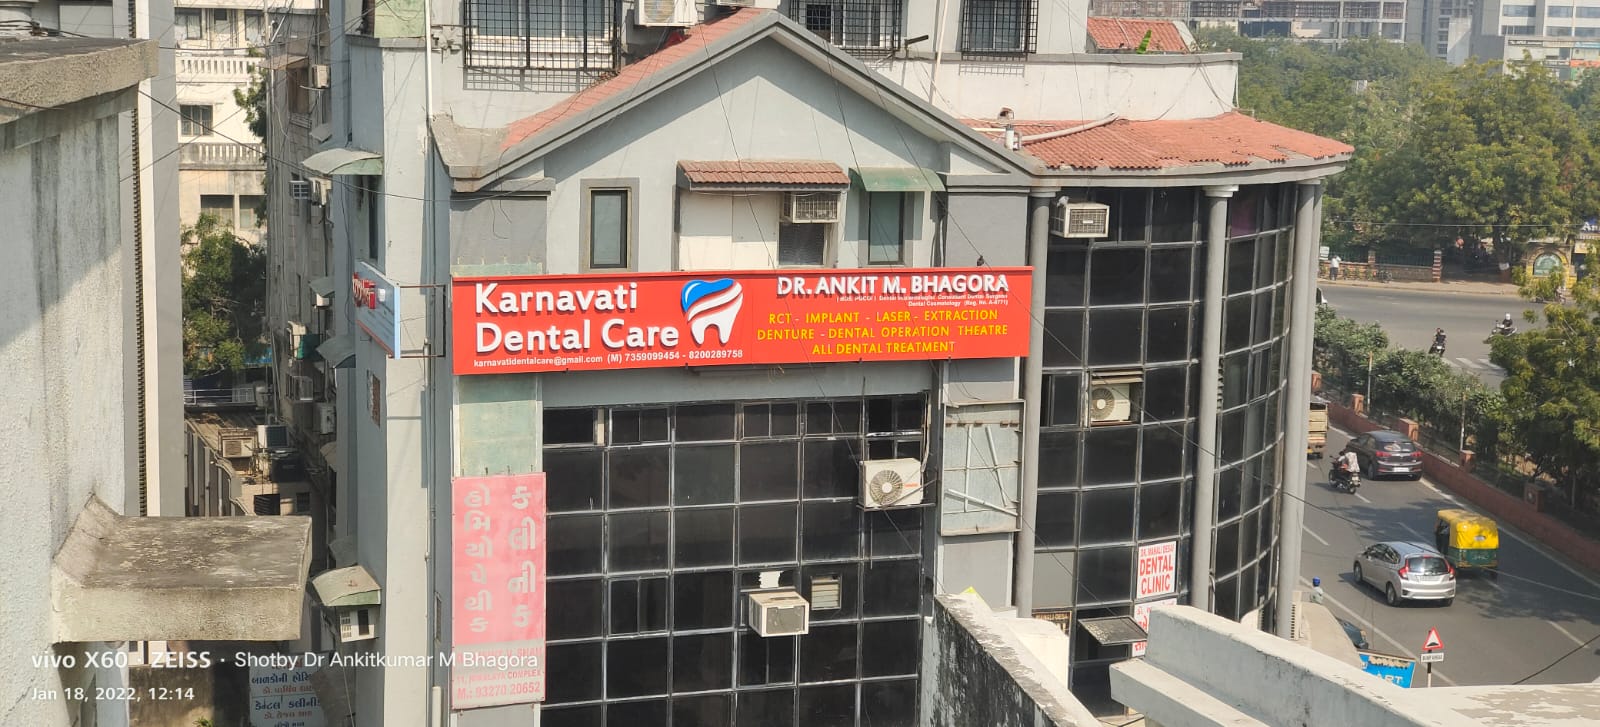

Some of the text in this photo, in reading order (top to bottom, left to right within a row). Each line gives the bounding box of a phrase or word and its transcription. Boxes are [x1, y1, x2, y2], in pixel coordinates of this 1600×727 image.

[777, 274, 1009, 295] DR. ANKIT M. BHAGORA
[475, 282, 638, 313] Karnavati
[768, 313, 791, 324] RCT
[805, 312, 860, 323] IMPLANT
[876, 311, 911, 322] LASER
[924, 310, 998, 321] EXTRACTION
[476, 319, 679, 352] Dental Care
[757, 328, 815, 340] DENTURE
[828, 327, 875, 339] DENTAL
[881, 326, 949, 337] OPERATION
[958, 324, 1008, 336] THEATRE
[812, 341, 955, 355] ALL DENTAL TREATMENT
[473, 355, 603, 367] karnavatidentalcare@gmail.com
[607, 353, 622, 364] (M)
[624, 351, 680, 362] 7359099454
[688, 349, 743, 360] 8200289758
[1140, 554, 1173, 576] DENTAL
[1141, 573, 1171, 595] CLINIC
[507, 669, 541, 679] COMPLEX
[510, 681, 541, 695] 20652
